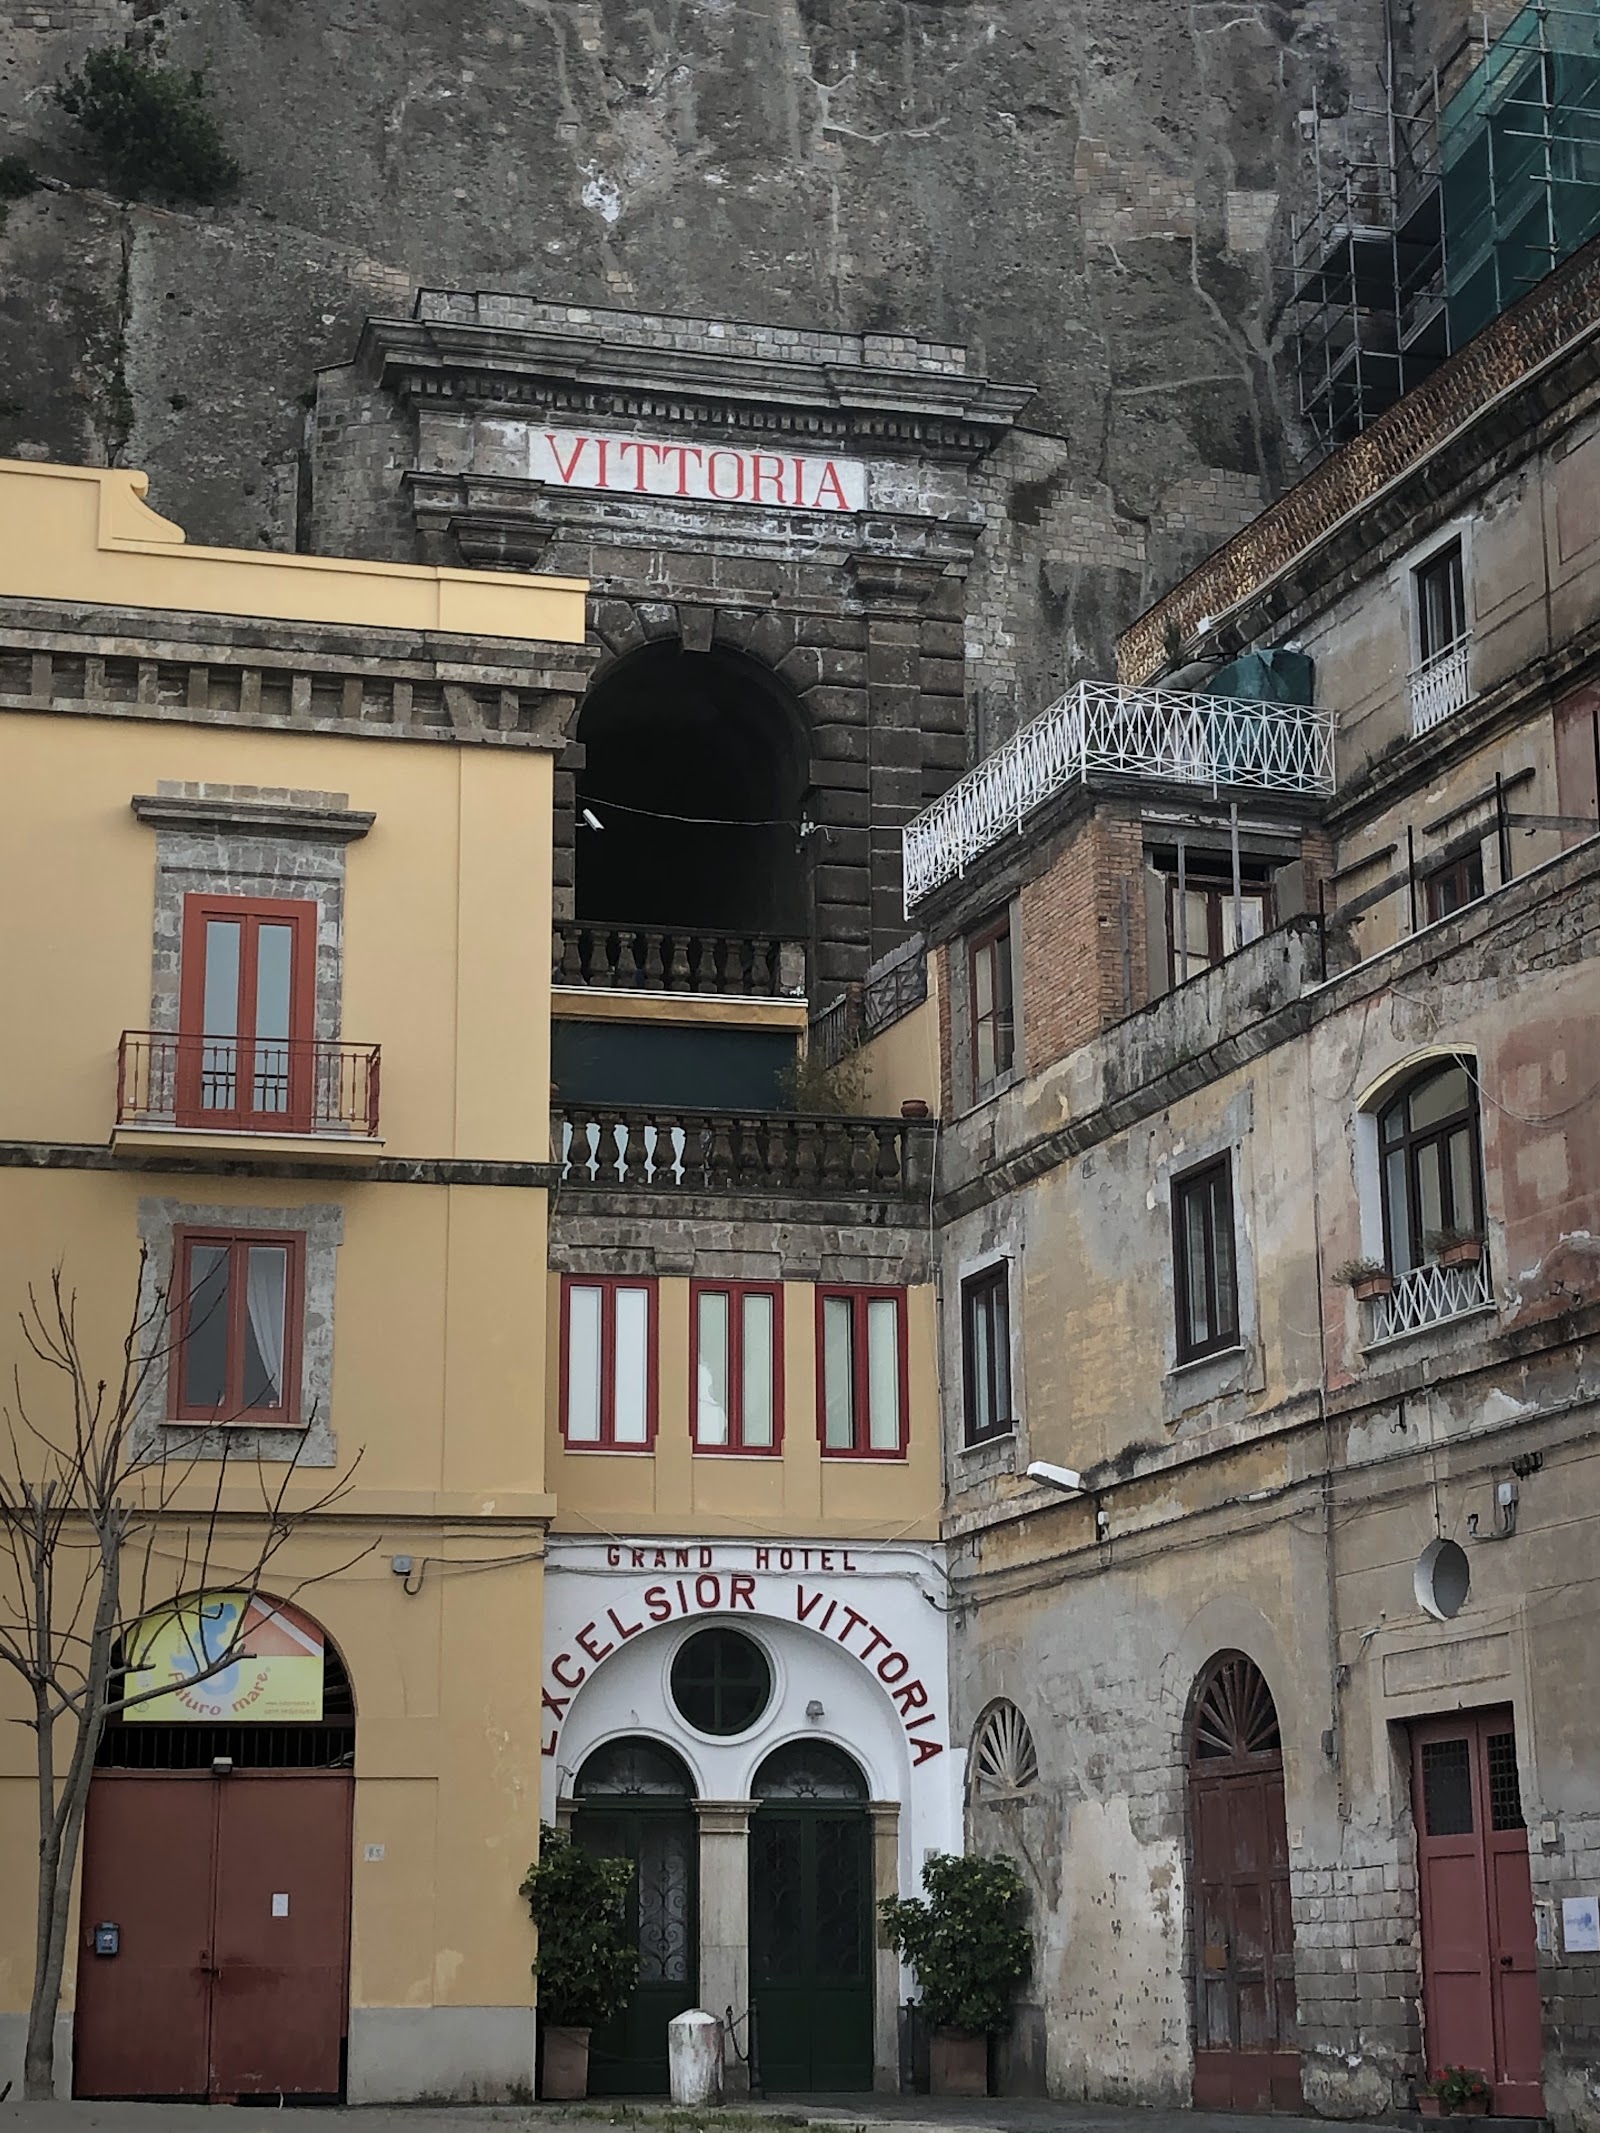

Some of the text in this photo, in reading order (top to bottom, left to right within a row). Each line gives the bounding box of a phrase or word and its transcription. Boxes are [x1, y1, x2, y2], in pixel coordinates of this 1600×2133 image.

[545, 434, 850, 510] VITTORIA
[606, 1545, 857, 1571] GRAND HOTEL
[168, 1672, 268, 1716] Fturo mare
[797, 1584, 944, 1767] VITTORIA
